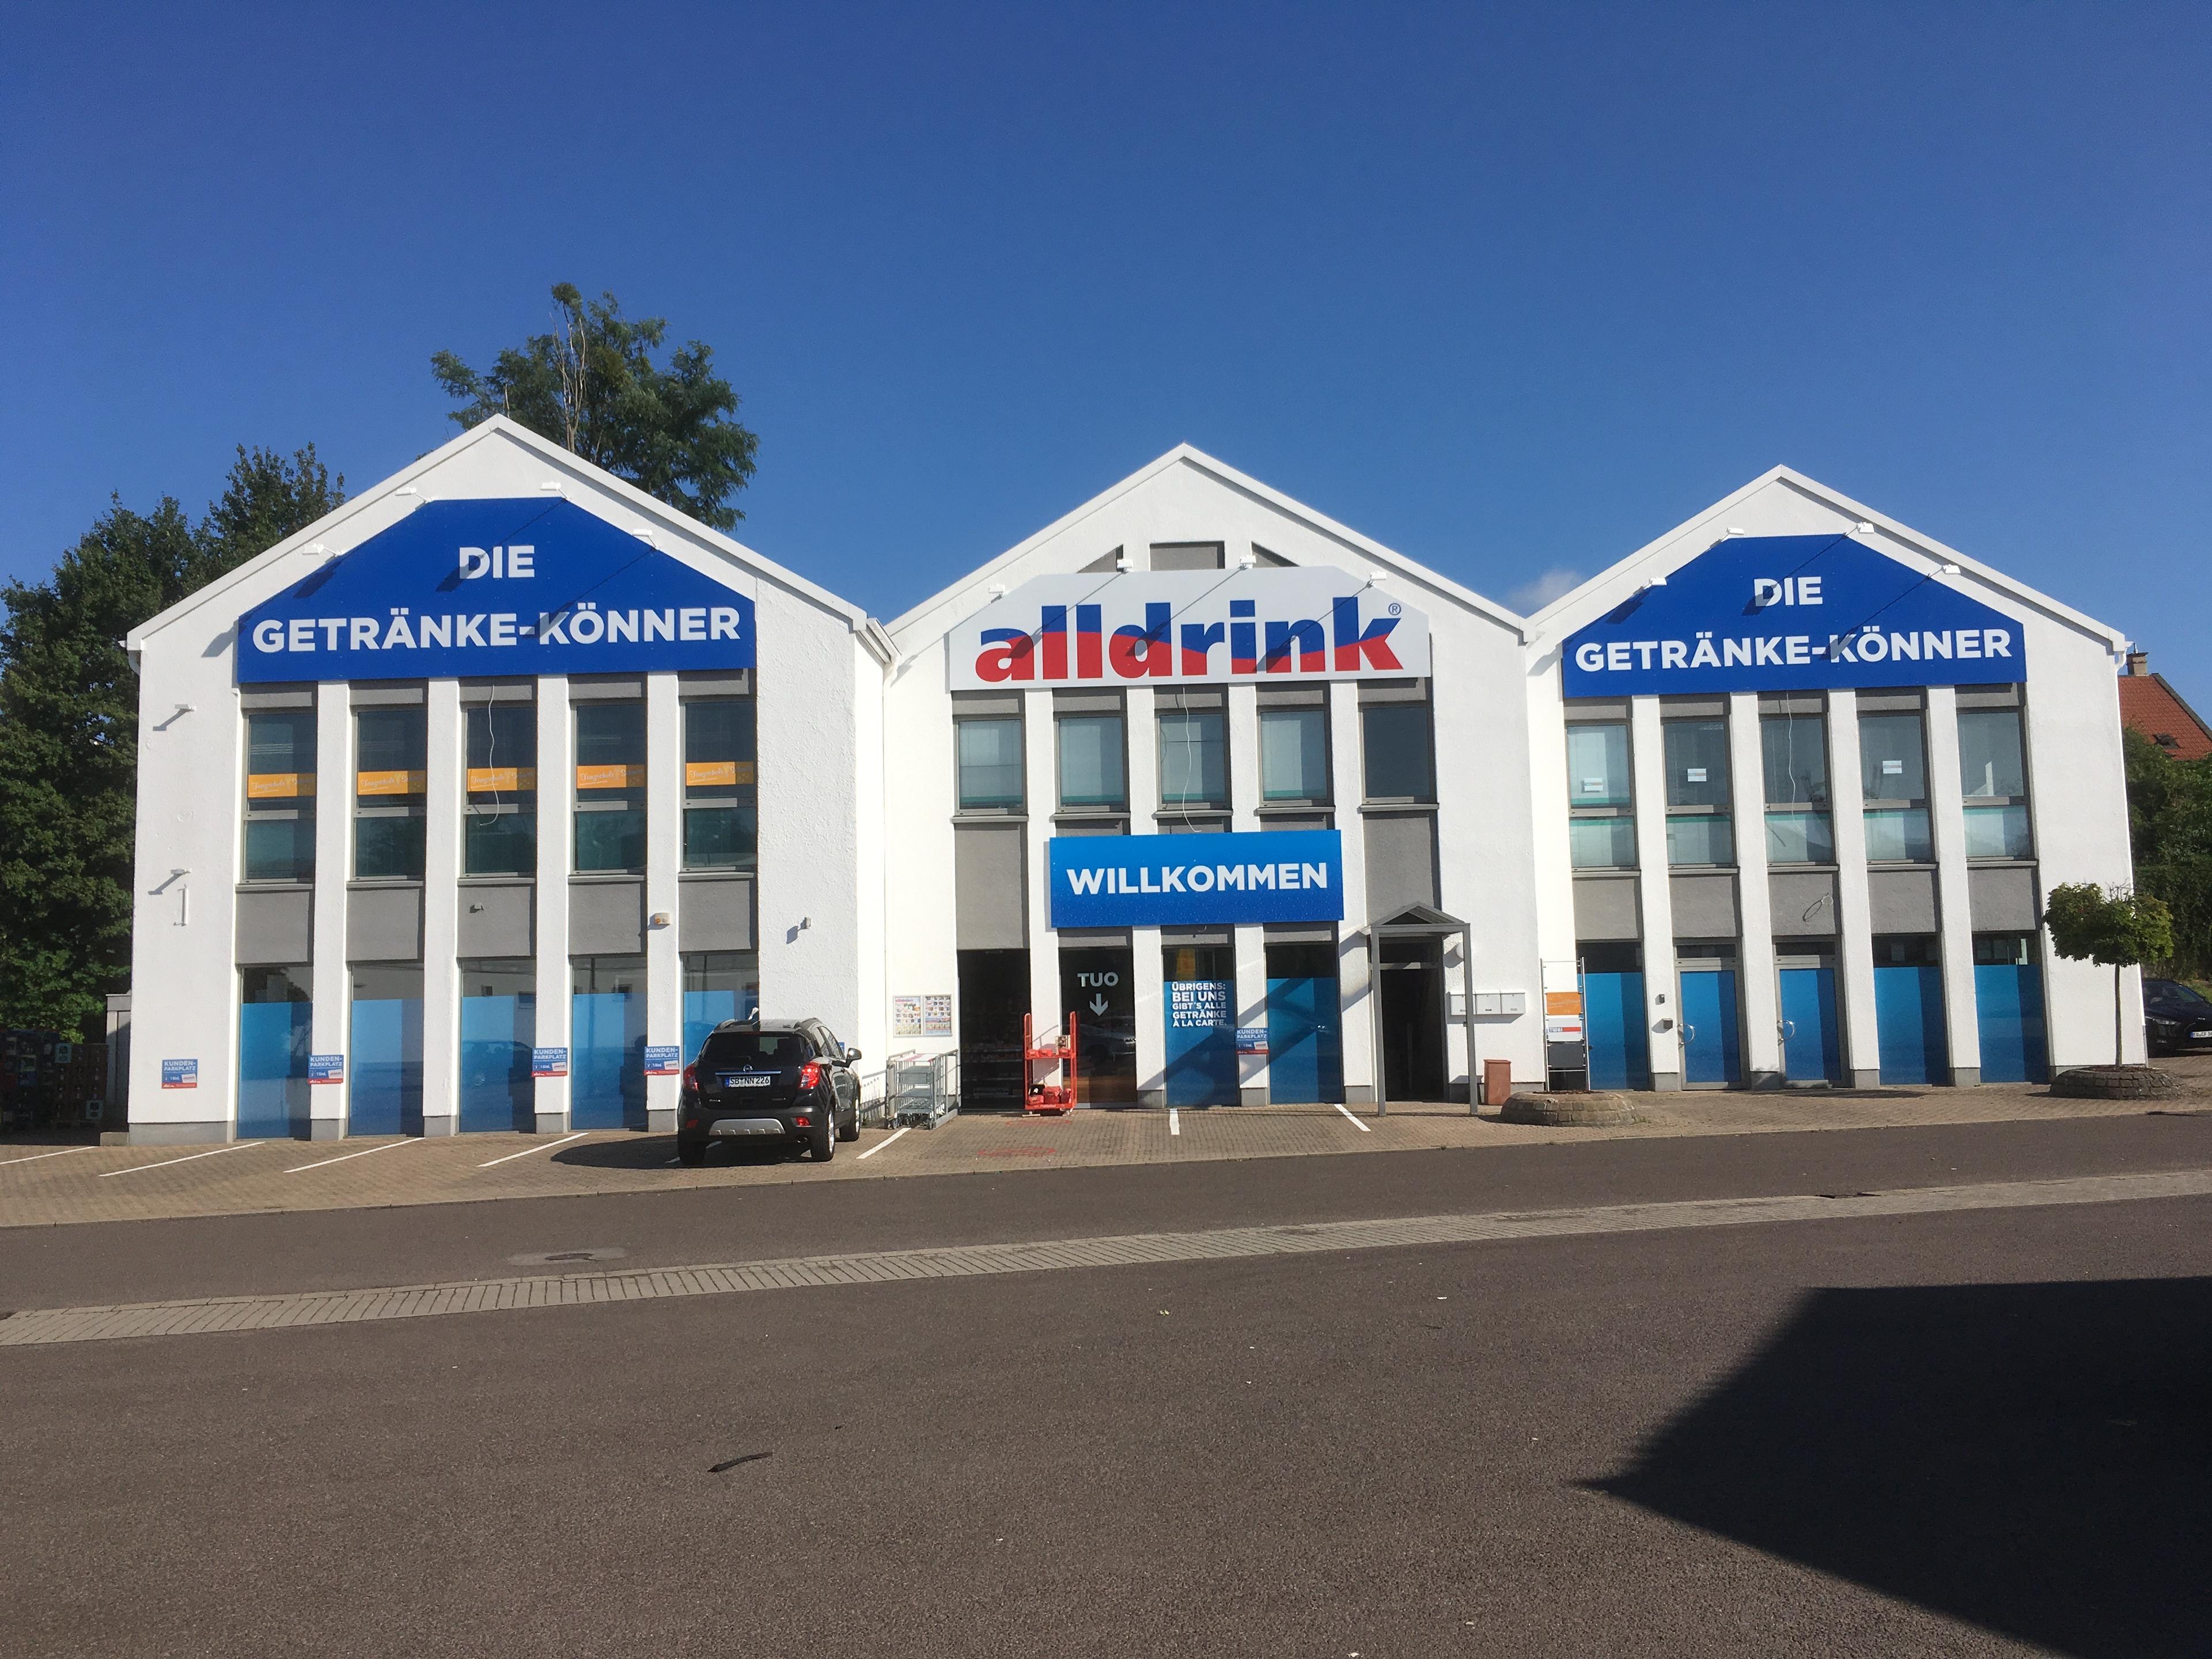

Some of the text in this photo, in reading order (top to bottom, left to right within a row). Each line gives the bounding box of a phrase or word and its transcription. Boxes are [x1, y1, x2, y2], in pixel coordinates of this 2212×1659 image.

[460, 545, 535, 579] DIE
[1753, 577, 1823, 607] DIE
[252, 603, 741, 653] GETRÄNKE-KÖNNER
[1575, 625, 2013, 672] GETRÄNKE-KÖNNER
[1066, 862, 1327, 895] WILLKOMMEN
[1172, 982, 1226, 991] ÜBRIGENS:
[1172, 991, 1226, 1002] BEI UNS
[1173, 1009, 1226, 1019] GETRÄNKE
